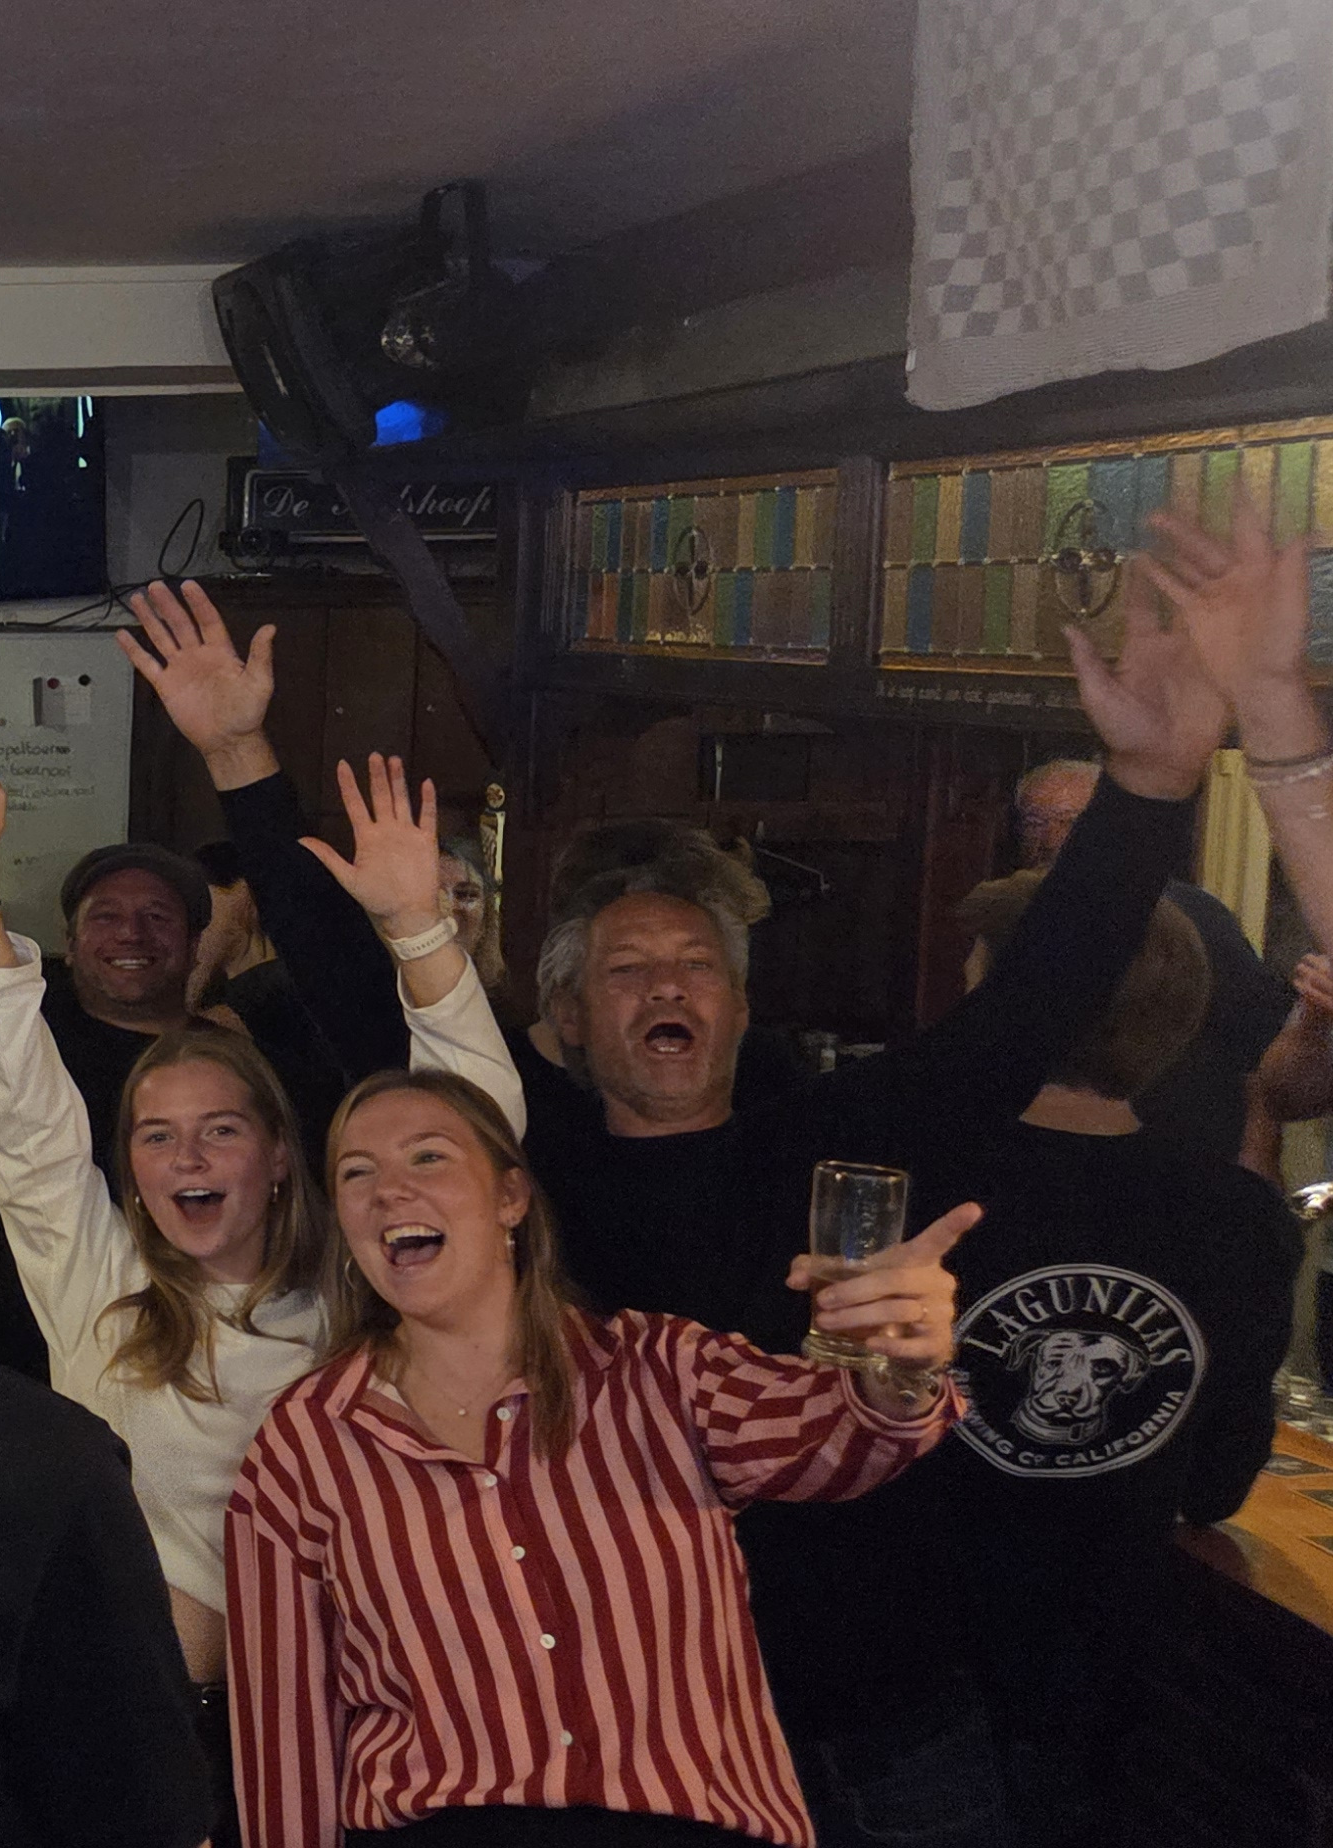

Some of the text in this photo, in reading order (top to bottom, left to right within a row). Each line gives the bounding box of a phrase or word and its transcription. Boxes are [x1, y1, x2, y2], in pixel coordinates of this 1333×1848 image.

[263, 485, 310, 518] De
[963, 1276, 1192, 1367] LAGUNITAS
[1055, 1390, 1185, 1466] CALIFORNIA
